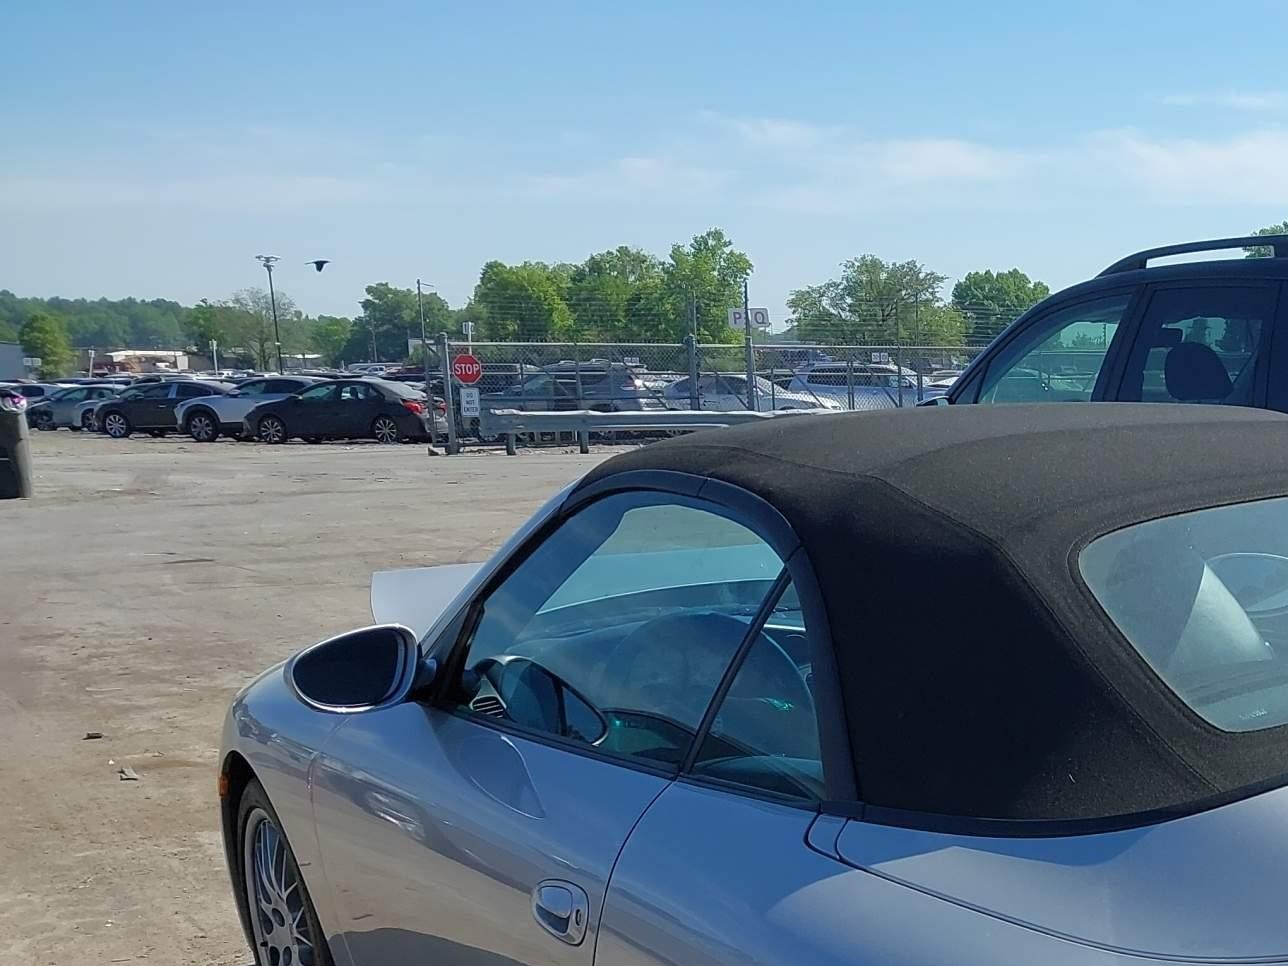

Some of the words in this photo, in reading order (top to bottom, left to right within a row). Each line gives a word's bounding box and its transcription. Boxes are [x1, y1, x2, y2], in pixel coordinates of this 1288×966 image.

[733, 311, 742, 325] P
[754, 311, 768, 325] Q
[454, 363, 480, 375] STOP
